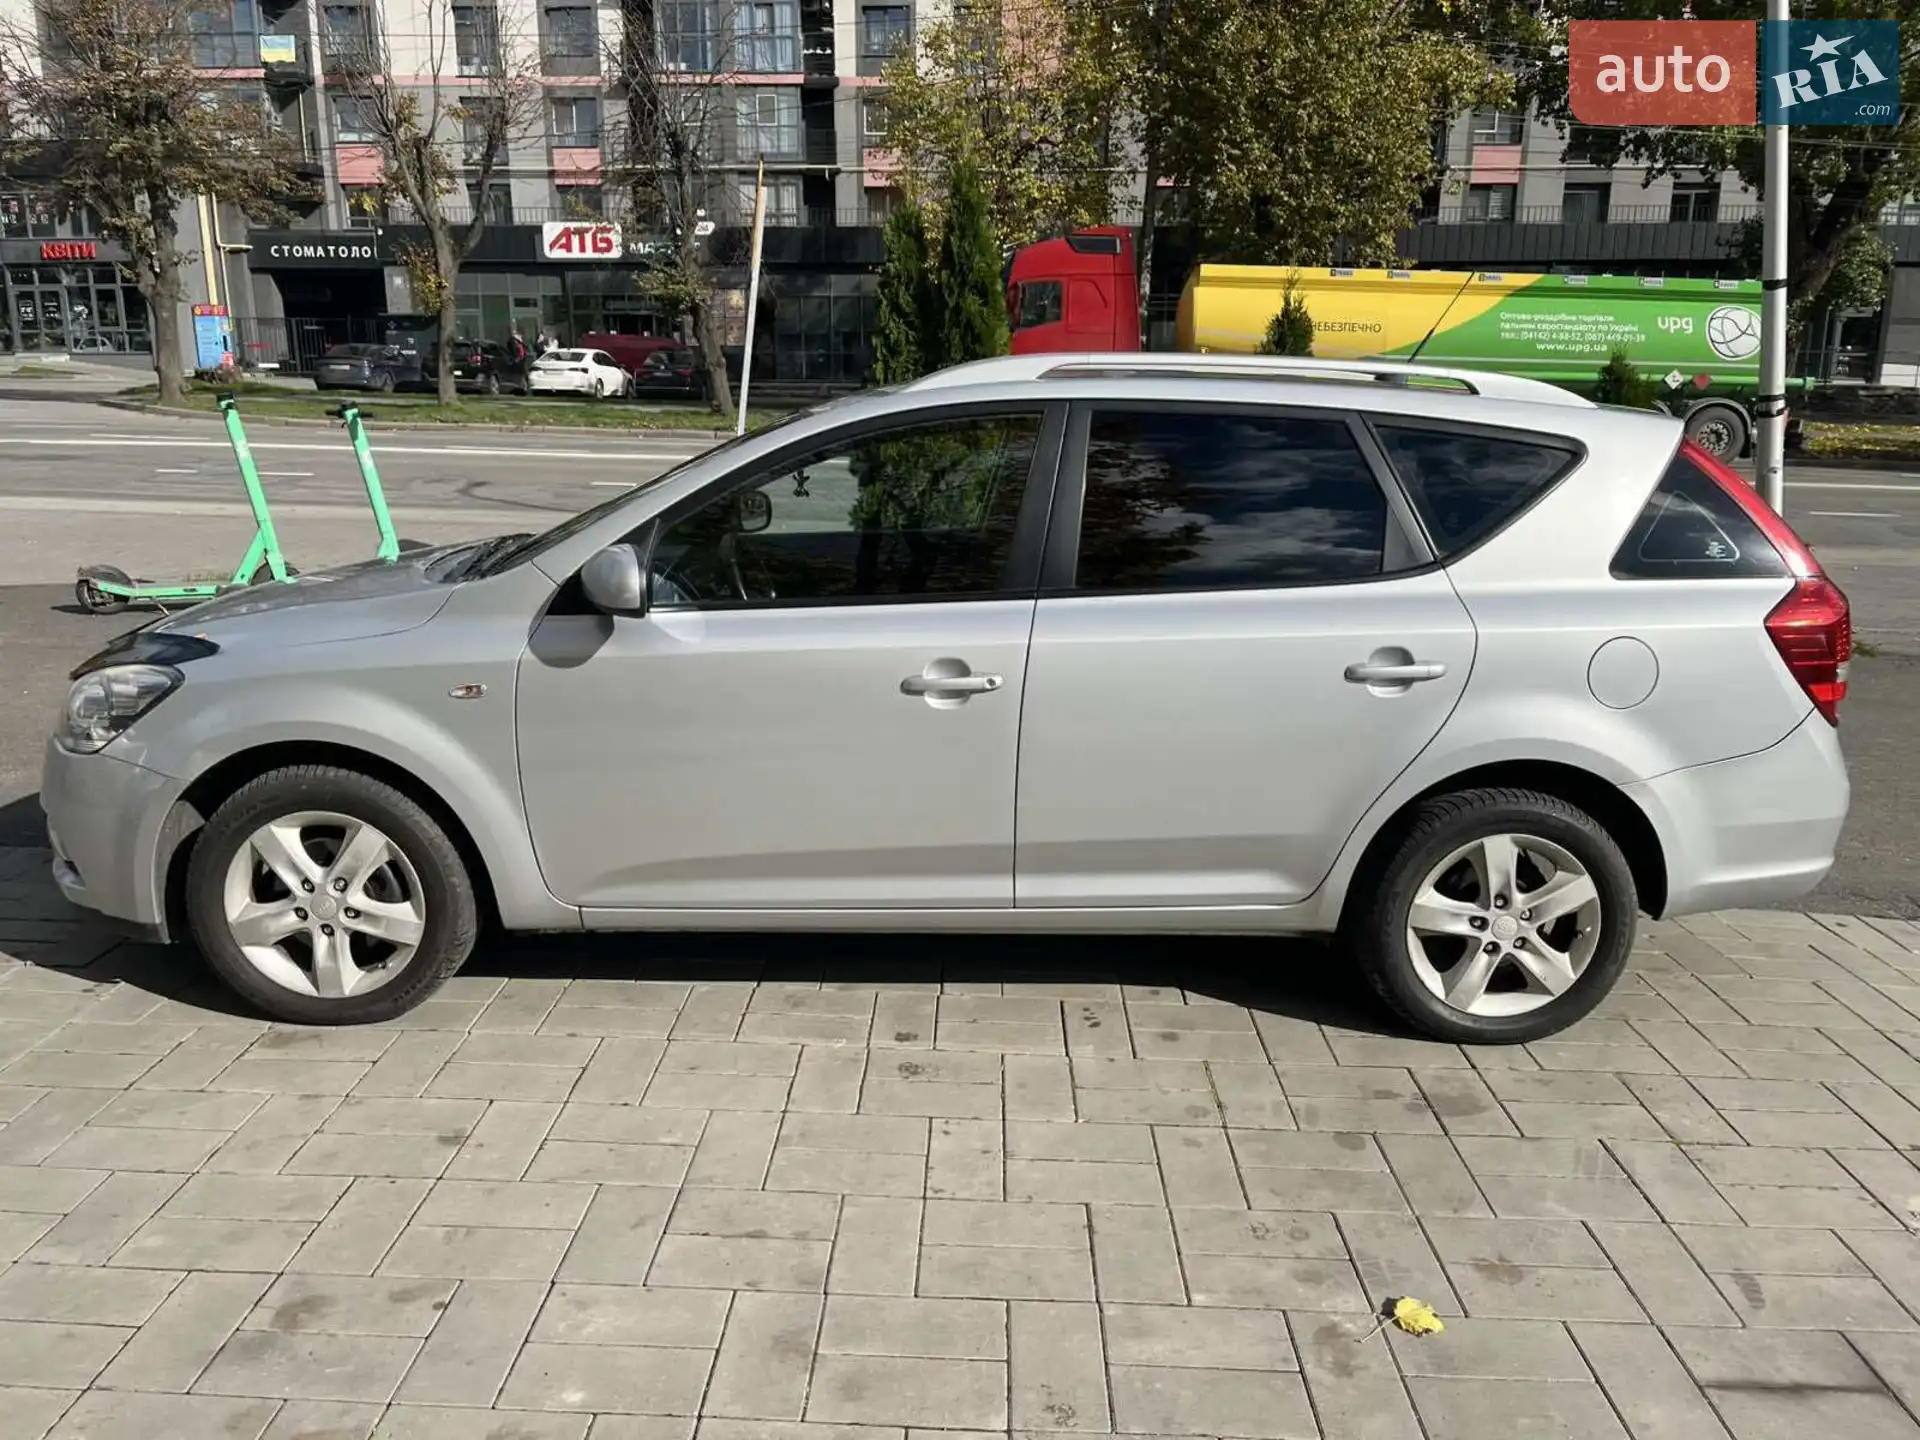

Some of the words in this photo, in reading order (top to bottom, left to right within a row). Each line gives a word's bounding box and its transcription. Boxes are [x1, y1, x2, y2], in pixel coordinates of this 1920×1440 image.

[549, 226, 614, 254] АТБ
[41, 241, 96, 261] КВІТИ
[1657, 316, 1694, 334] upg
[1536, 343, 1608, 352] www.upg.ua
